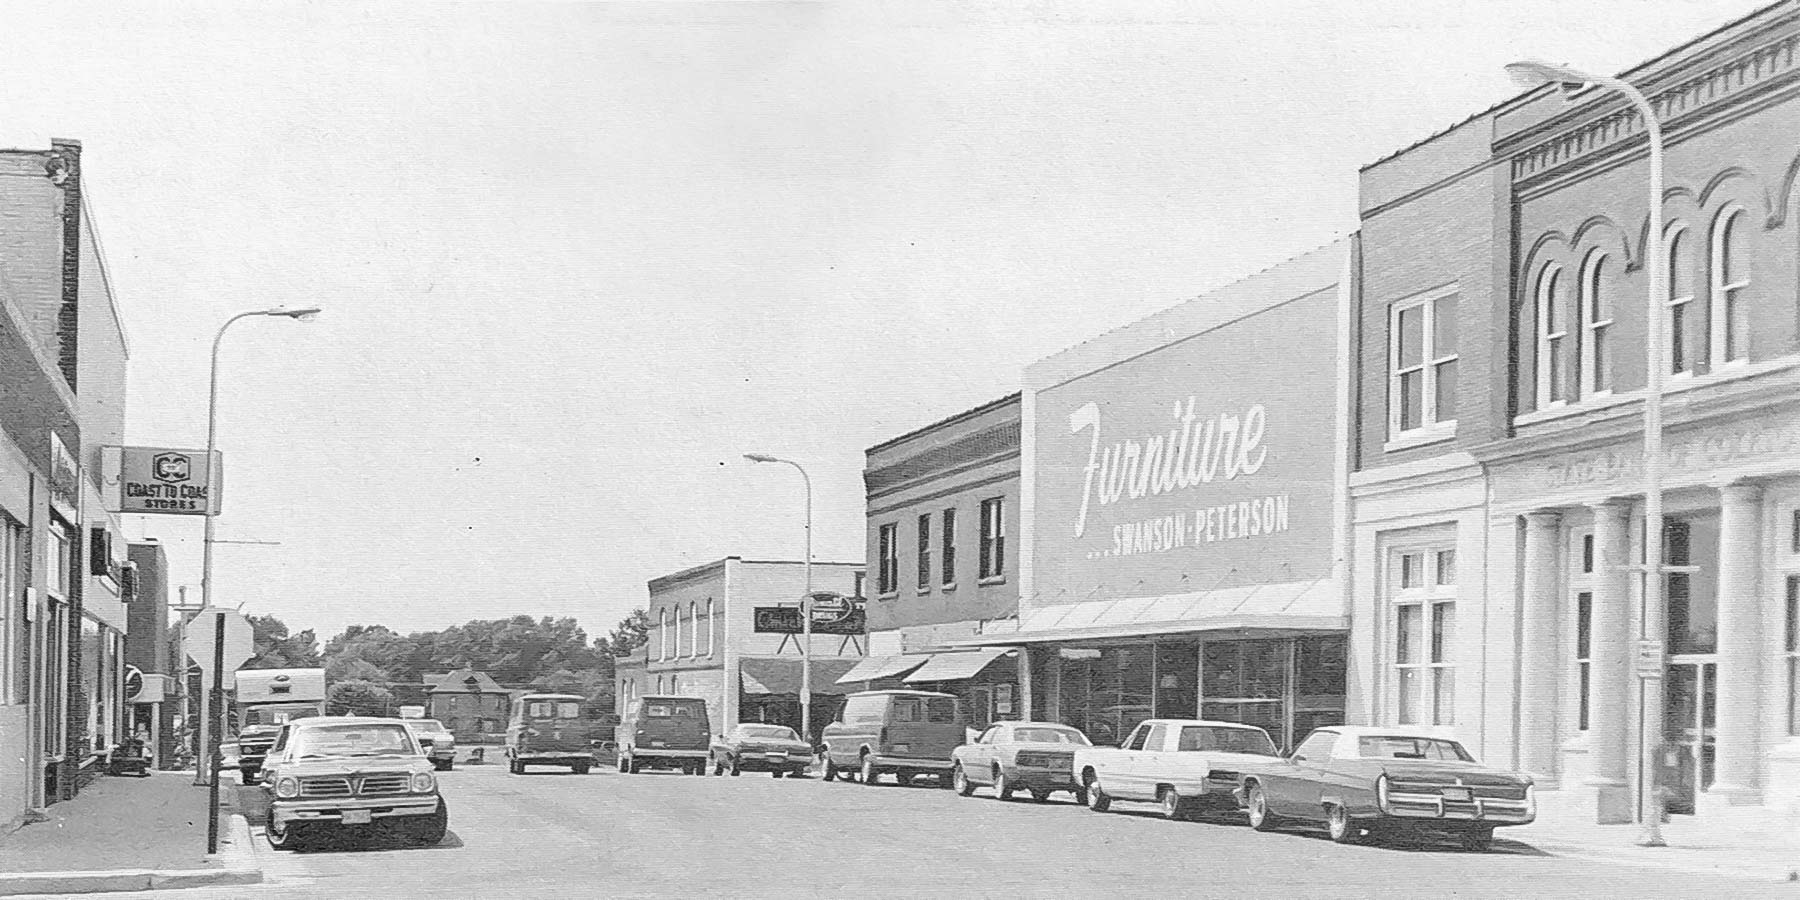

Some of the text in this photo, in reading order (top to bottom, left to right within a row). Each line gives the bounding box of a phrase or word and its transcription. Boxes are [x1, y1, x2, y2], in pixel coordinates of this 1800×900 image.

[1069, 396, 1267, 538] Furniture
[127, 483, 208, 499] COAST TO COAS
[144, 499, 196, 509] STORES
